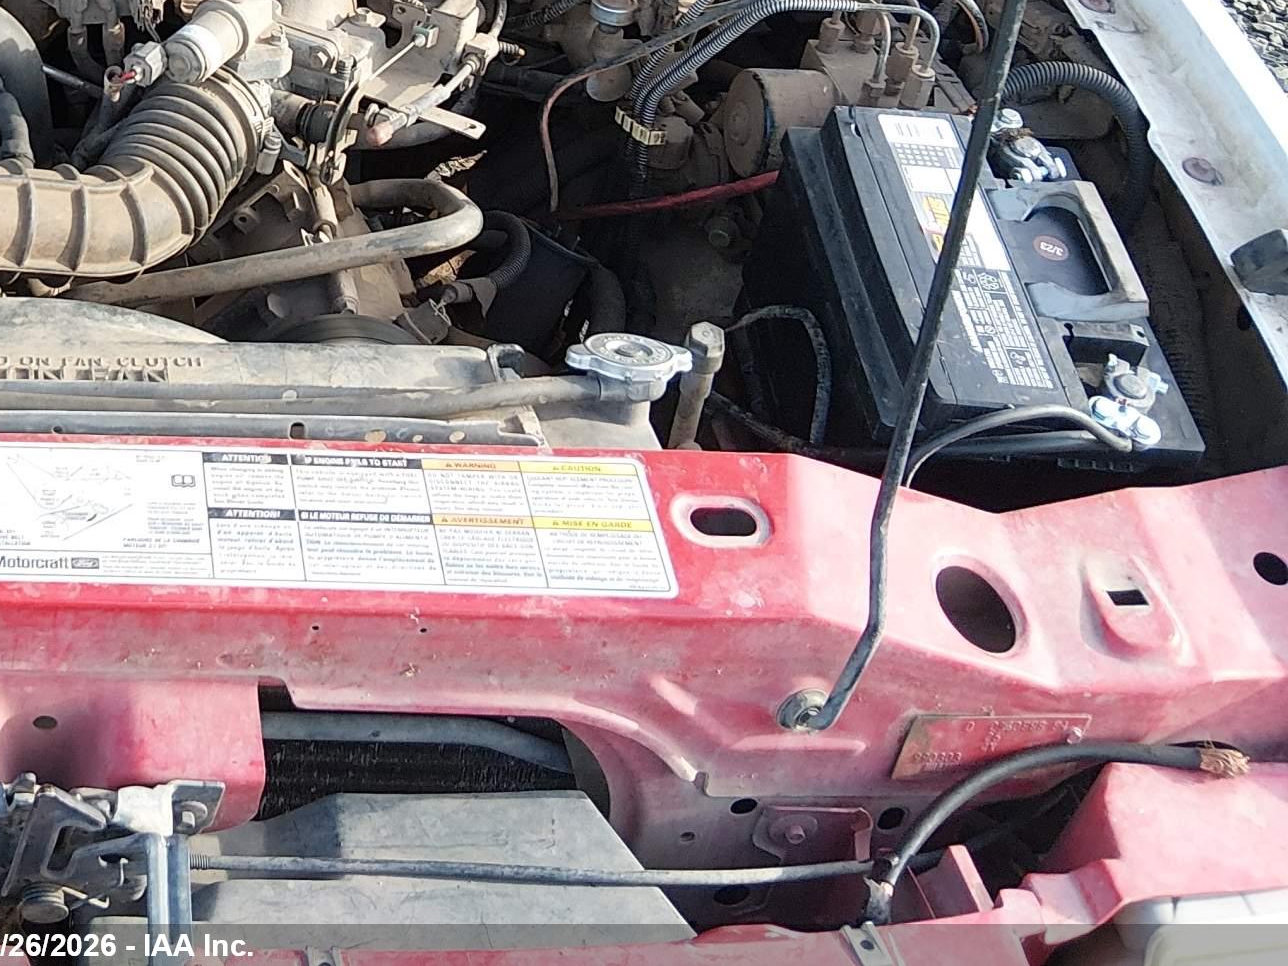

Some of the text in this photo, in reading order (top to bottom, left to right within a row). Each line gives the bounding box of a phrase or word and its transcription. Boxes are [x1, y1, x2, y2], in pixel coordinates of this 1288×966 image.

[20, 354, 50, 367] ON
[62, 355, 102, 368] FAN
[116, 356, 203, 369] CLUTCH
[370, 458, 381, 466] TO
[383, 458, 408, 467] START
[454, 462, 497, 470] WARNING
[450, 517, 525, 526] AVERTISSEMENT
[600, 521, 632, 529] GARDE
